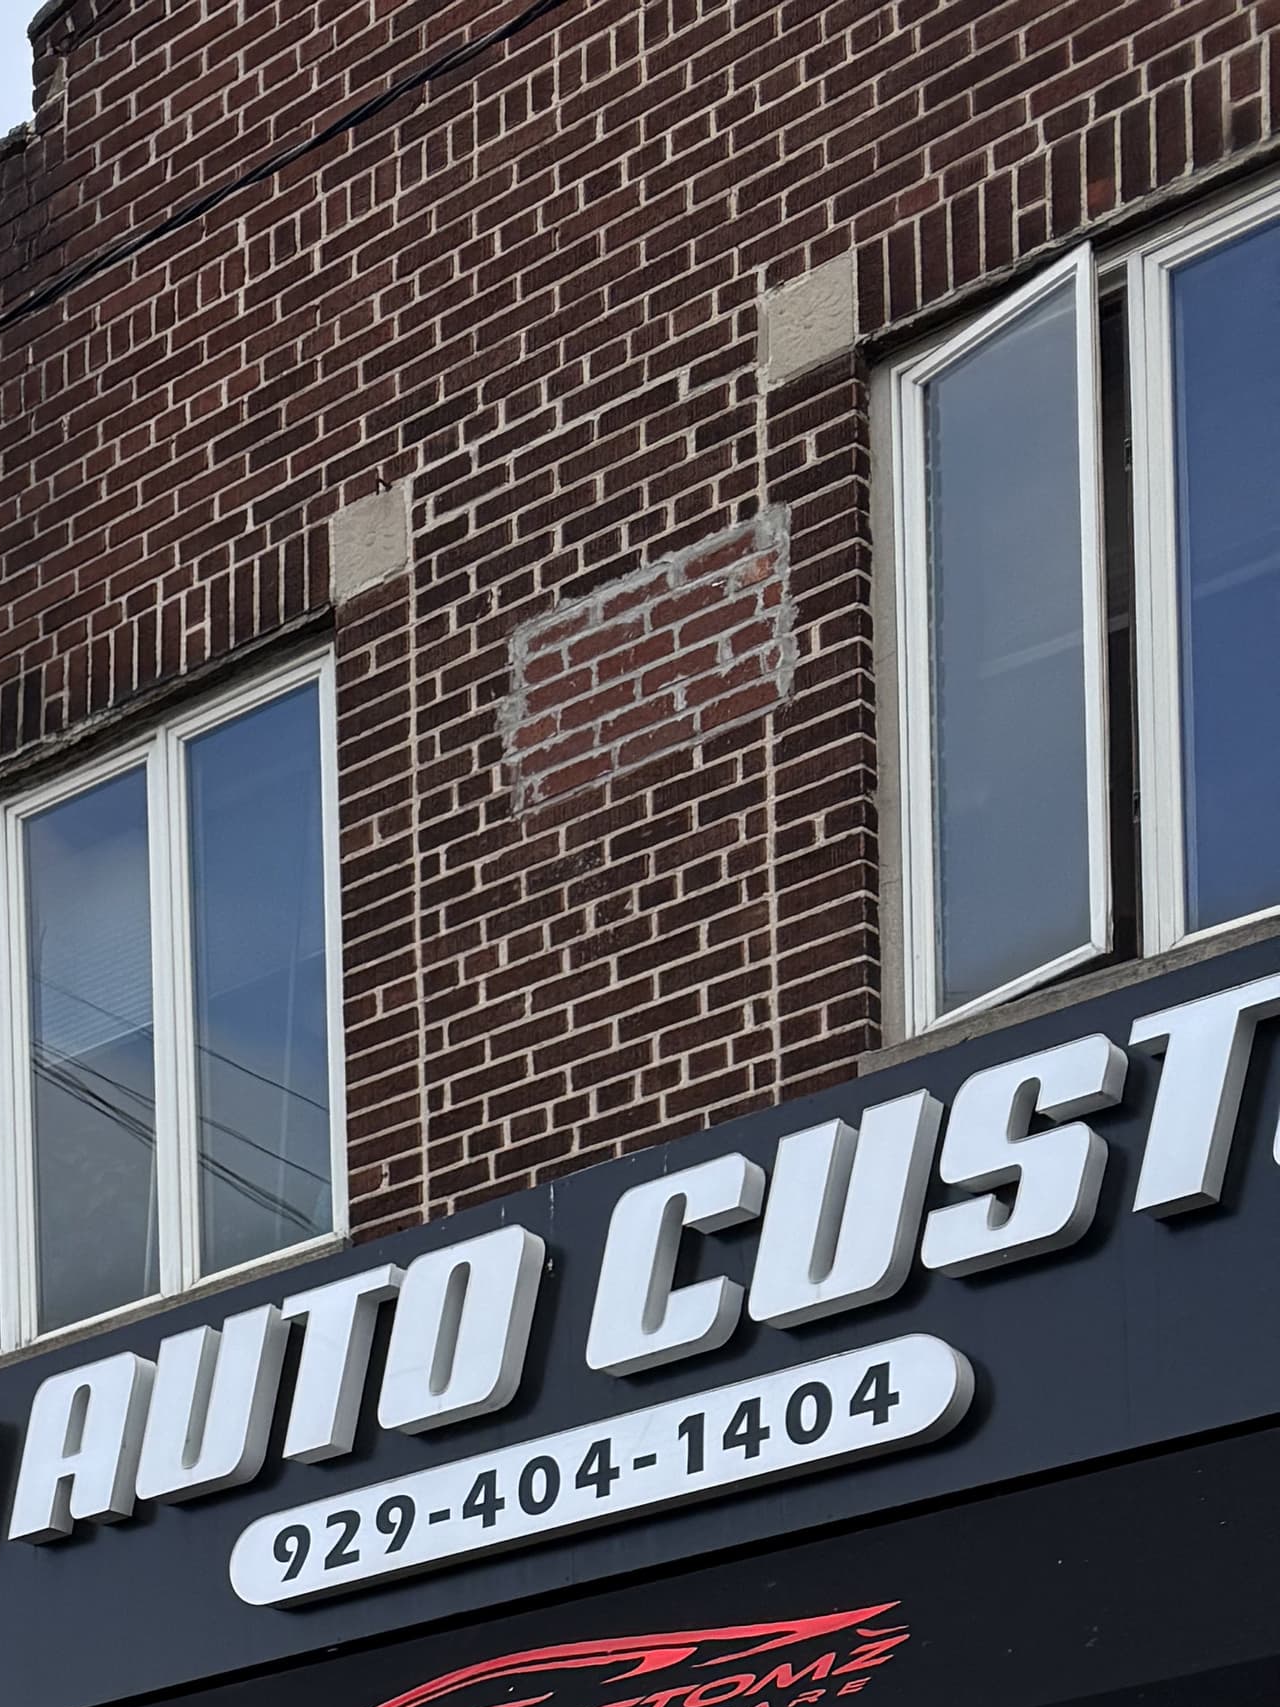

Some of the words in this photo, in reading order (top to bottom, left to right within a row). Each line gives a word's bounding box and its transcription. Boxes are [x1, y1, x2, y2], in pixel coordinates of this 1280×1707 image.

[7, 1225, 546, 1544] AUTO
[587, 973, 1280, 1375] CUST
[270, 1359, 902, 1584] 929-404-1404
